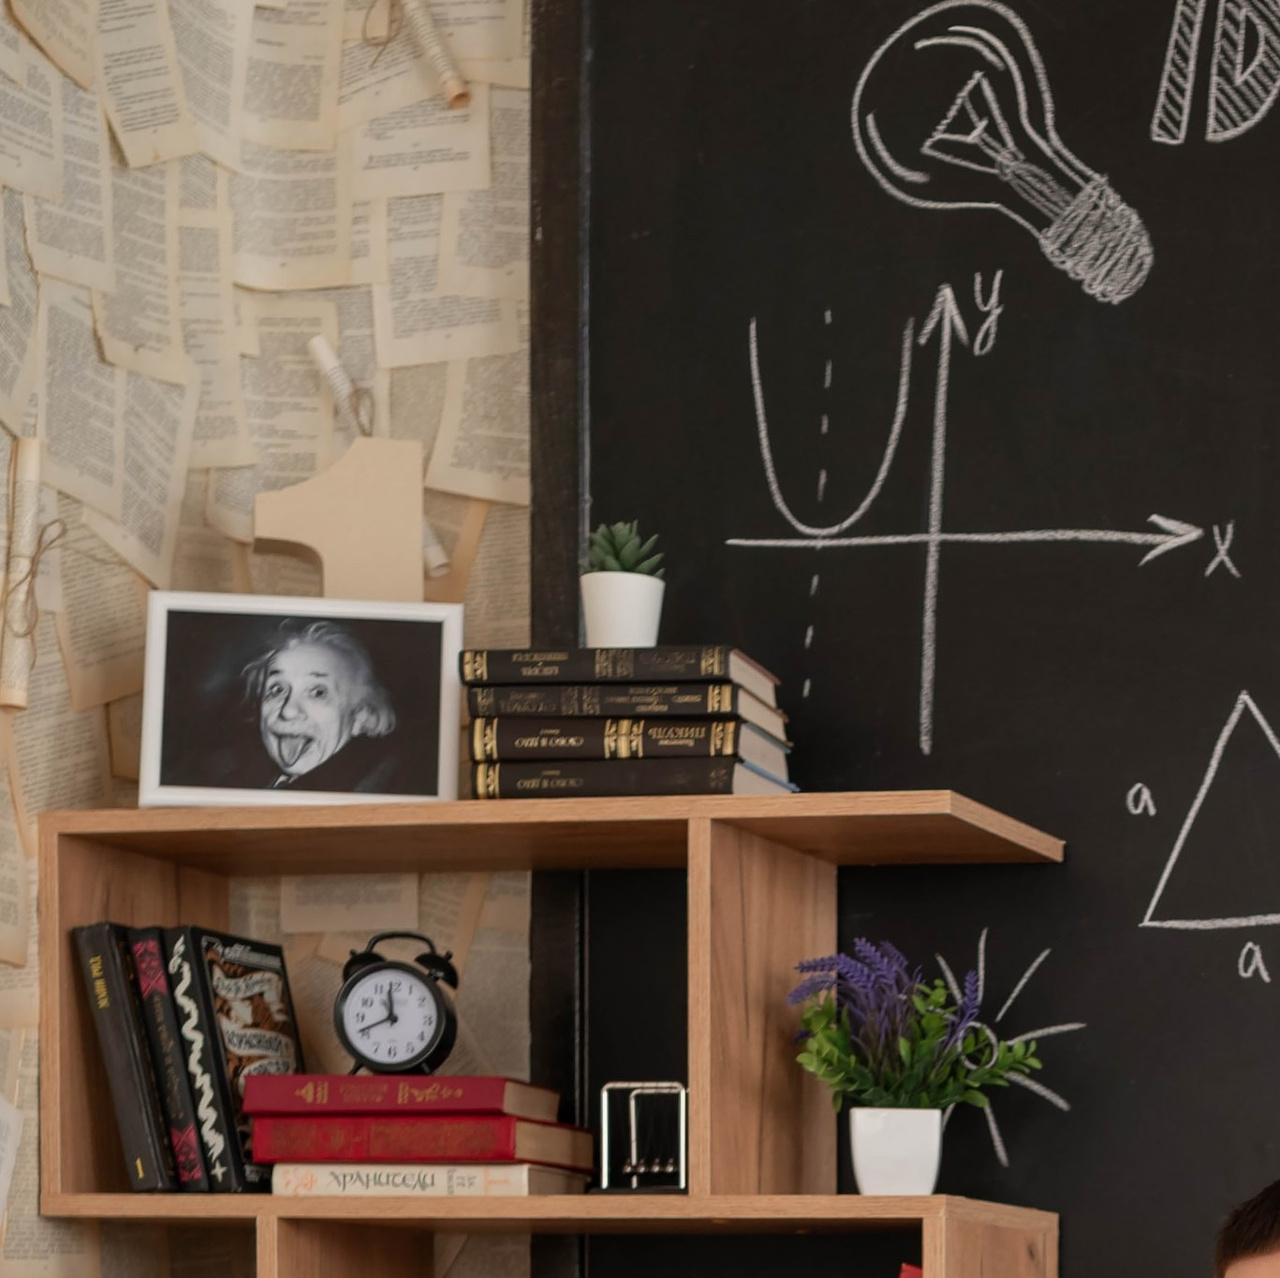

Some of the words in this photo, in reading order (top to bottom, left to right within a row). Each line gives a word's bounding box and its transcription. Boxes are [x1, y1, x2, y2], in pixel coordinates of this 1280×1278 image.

[975, 271, 1002, 354] y
[1128, 783, 1156, 815] a
[1239, 942, 1270, 982] a
